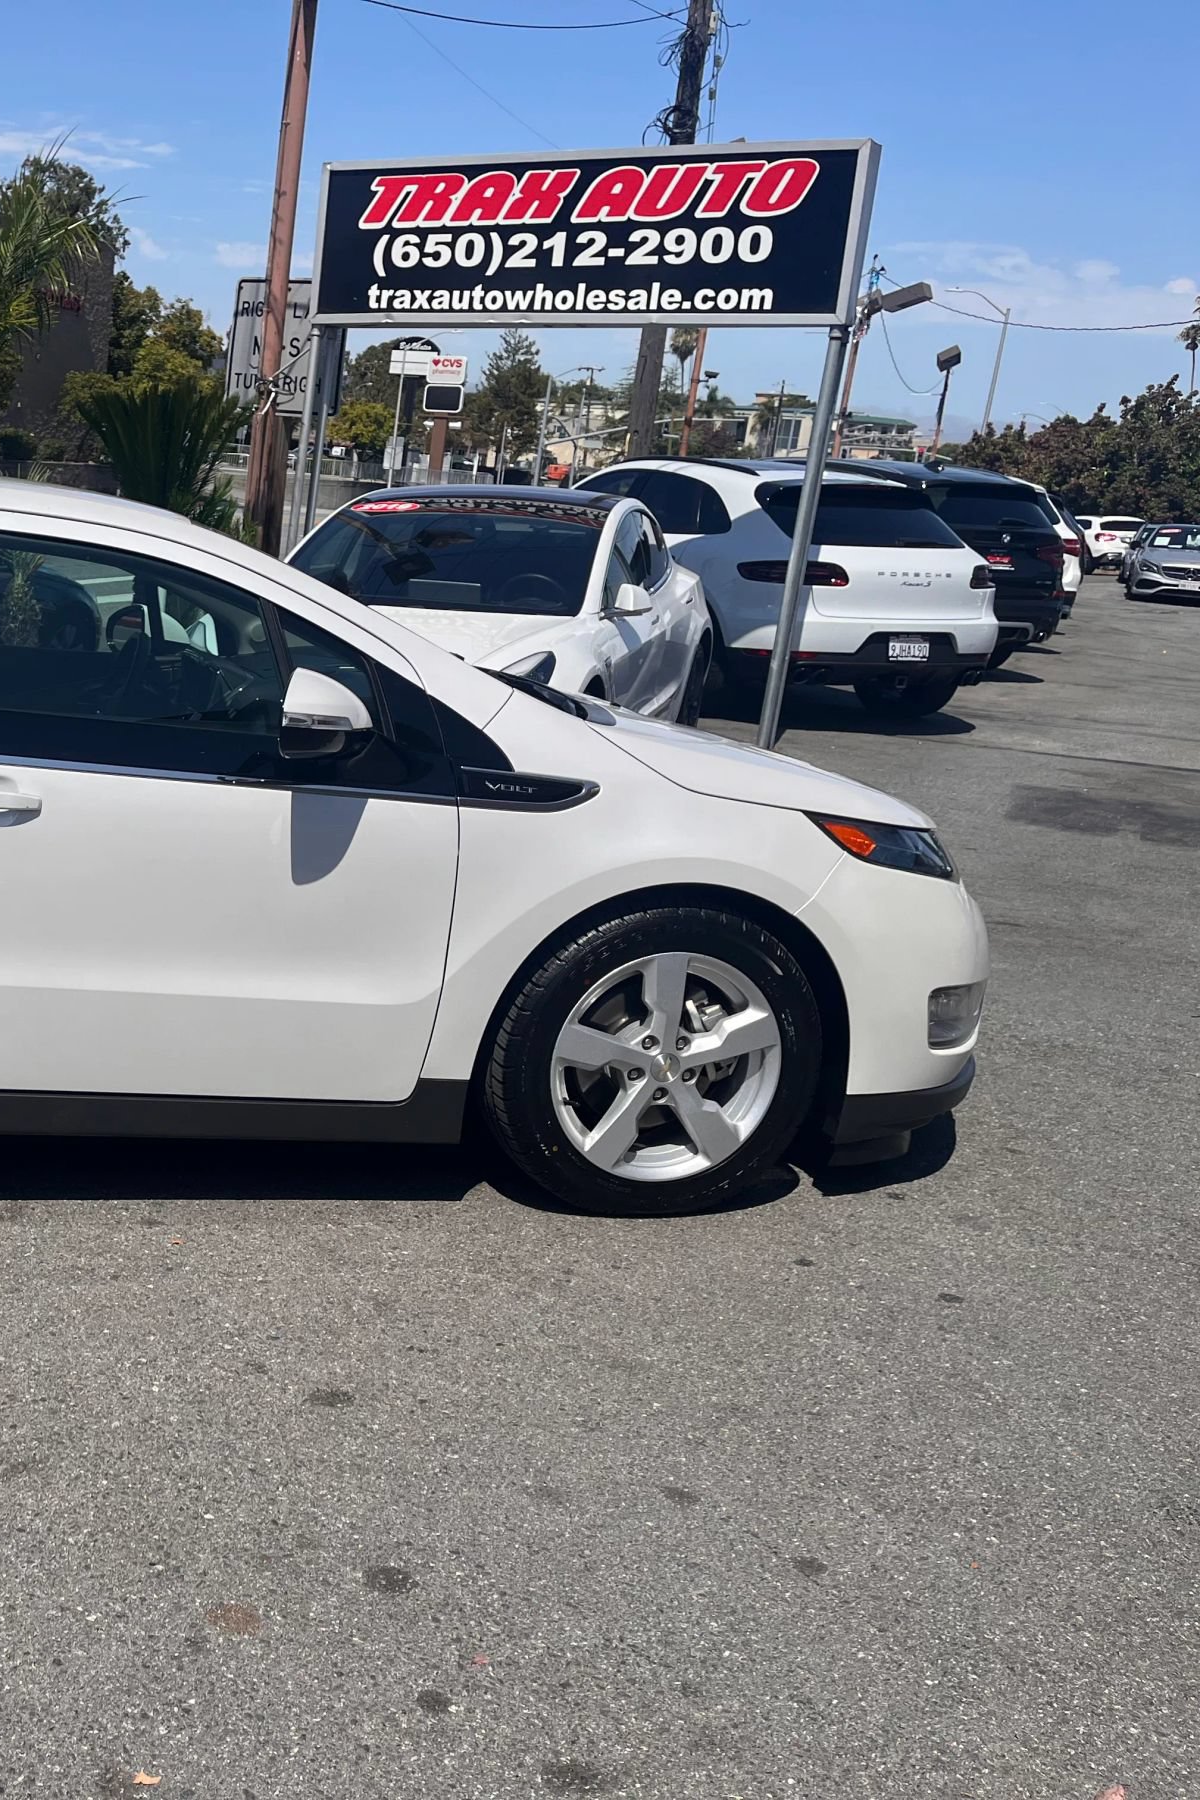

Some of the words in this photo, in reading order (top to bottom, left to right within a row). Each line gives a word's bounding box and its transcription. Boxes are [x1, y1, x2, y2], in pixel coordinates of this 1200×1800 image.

[359, 168, 580, 229] TRAX
[571, 158, 820, 224] AUTO
[372, 224, 774, 276] (650)212-2900
[367, 281, 774, 311] traxautowholesale.com
[441, 358, 463, 368] CVS
[890, 643, 929, 657] 9JHA190
[485, 780, 537, 794] VOLT
